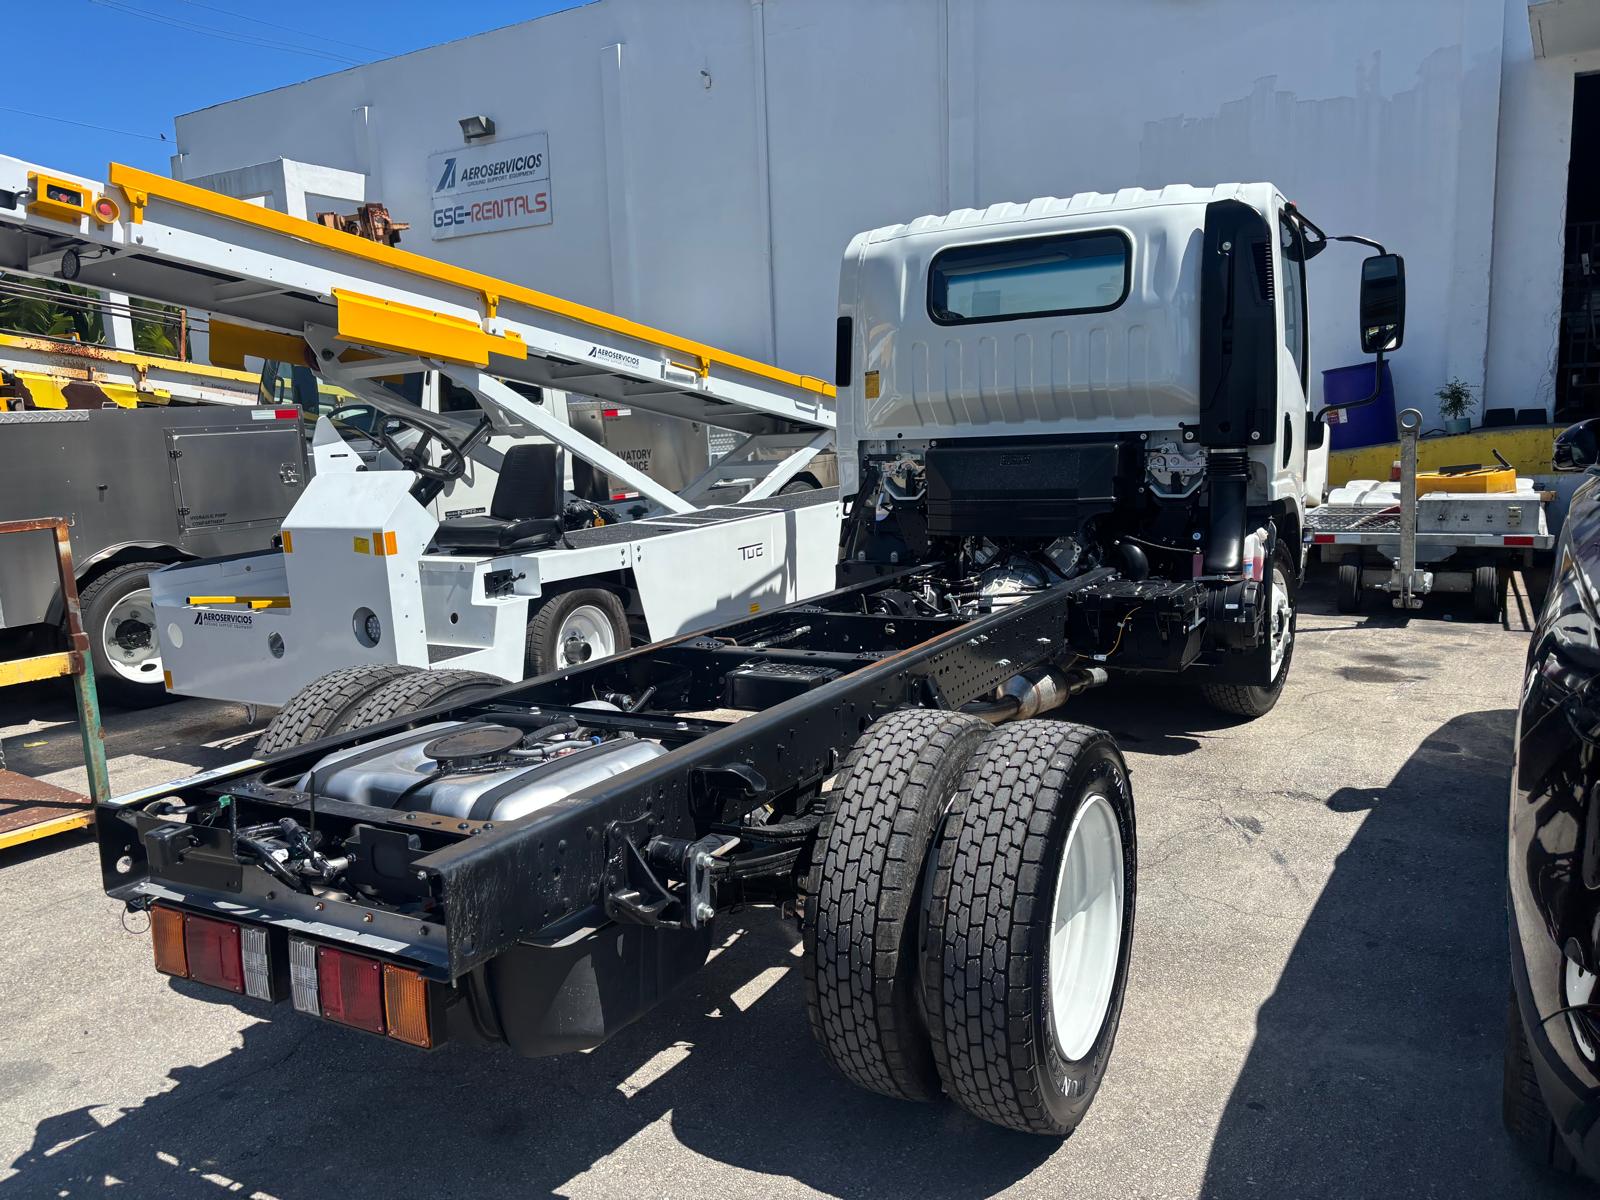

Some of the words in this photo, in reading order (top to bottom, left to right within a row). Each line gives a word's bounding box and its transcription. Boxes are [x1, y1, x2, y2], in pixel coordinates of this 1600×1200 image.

[461, 153, 542, 182] AEROSERVICIOS
[487, 174, 508, 183] SUPPORT
[509, 169, 536, 179] EQUIPMENT
[433, 192, 547, 228] GSE-RENTALS
[597, 348, 639, 366] AEROSERVICIOS
[616, 449, 652, 460] AVATORY
[626, 461, 649, 471] VICE
[203, 612, 252, 624] AEROSERVICIOS
